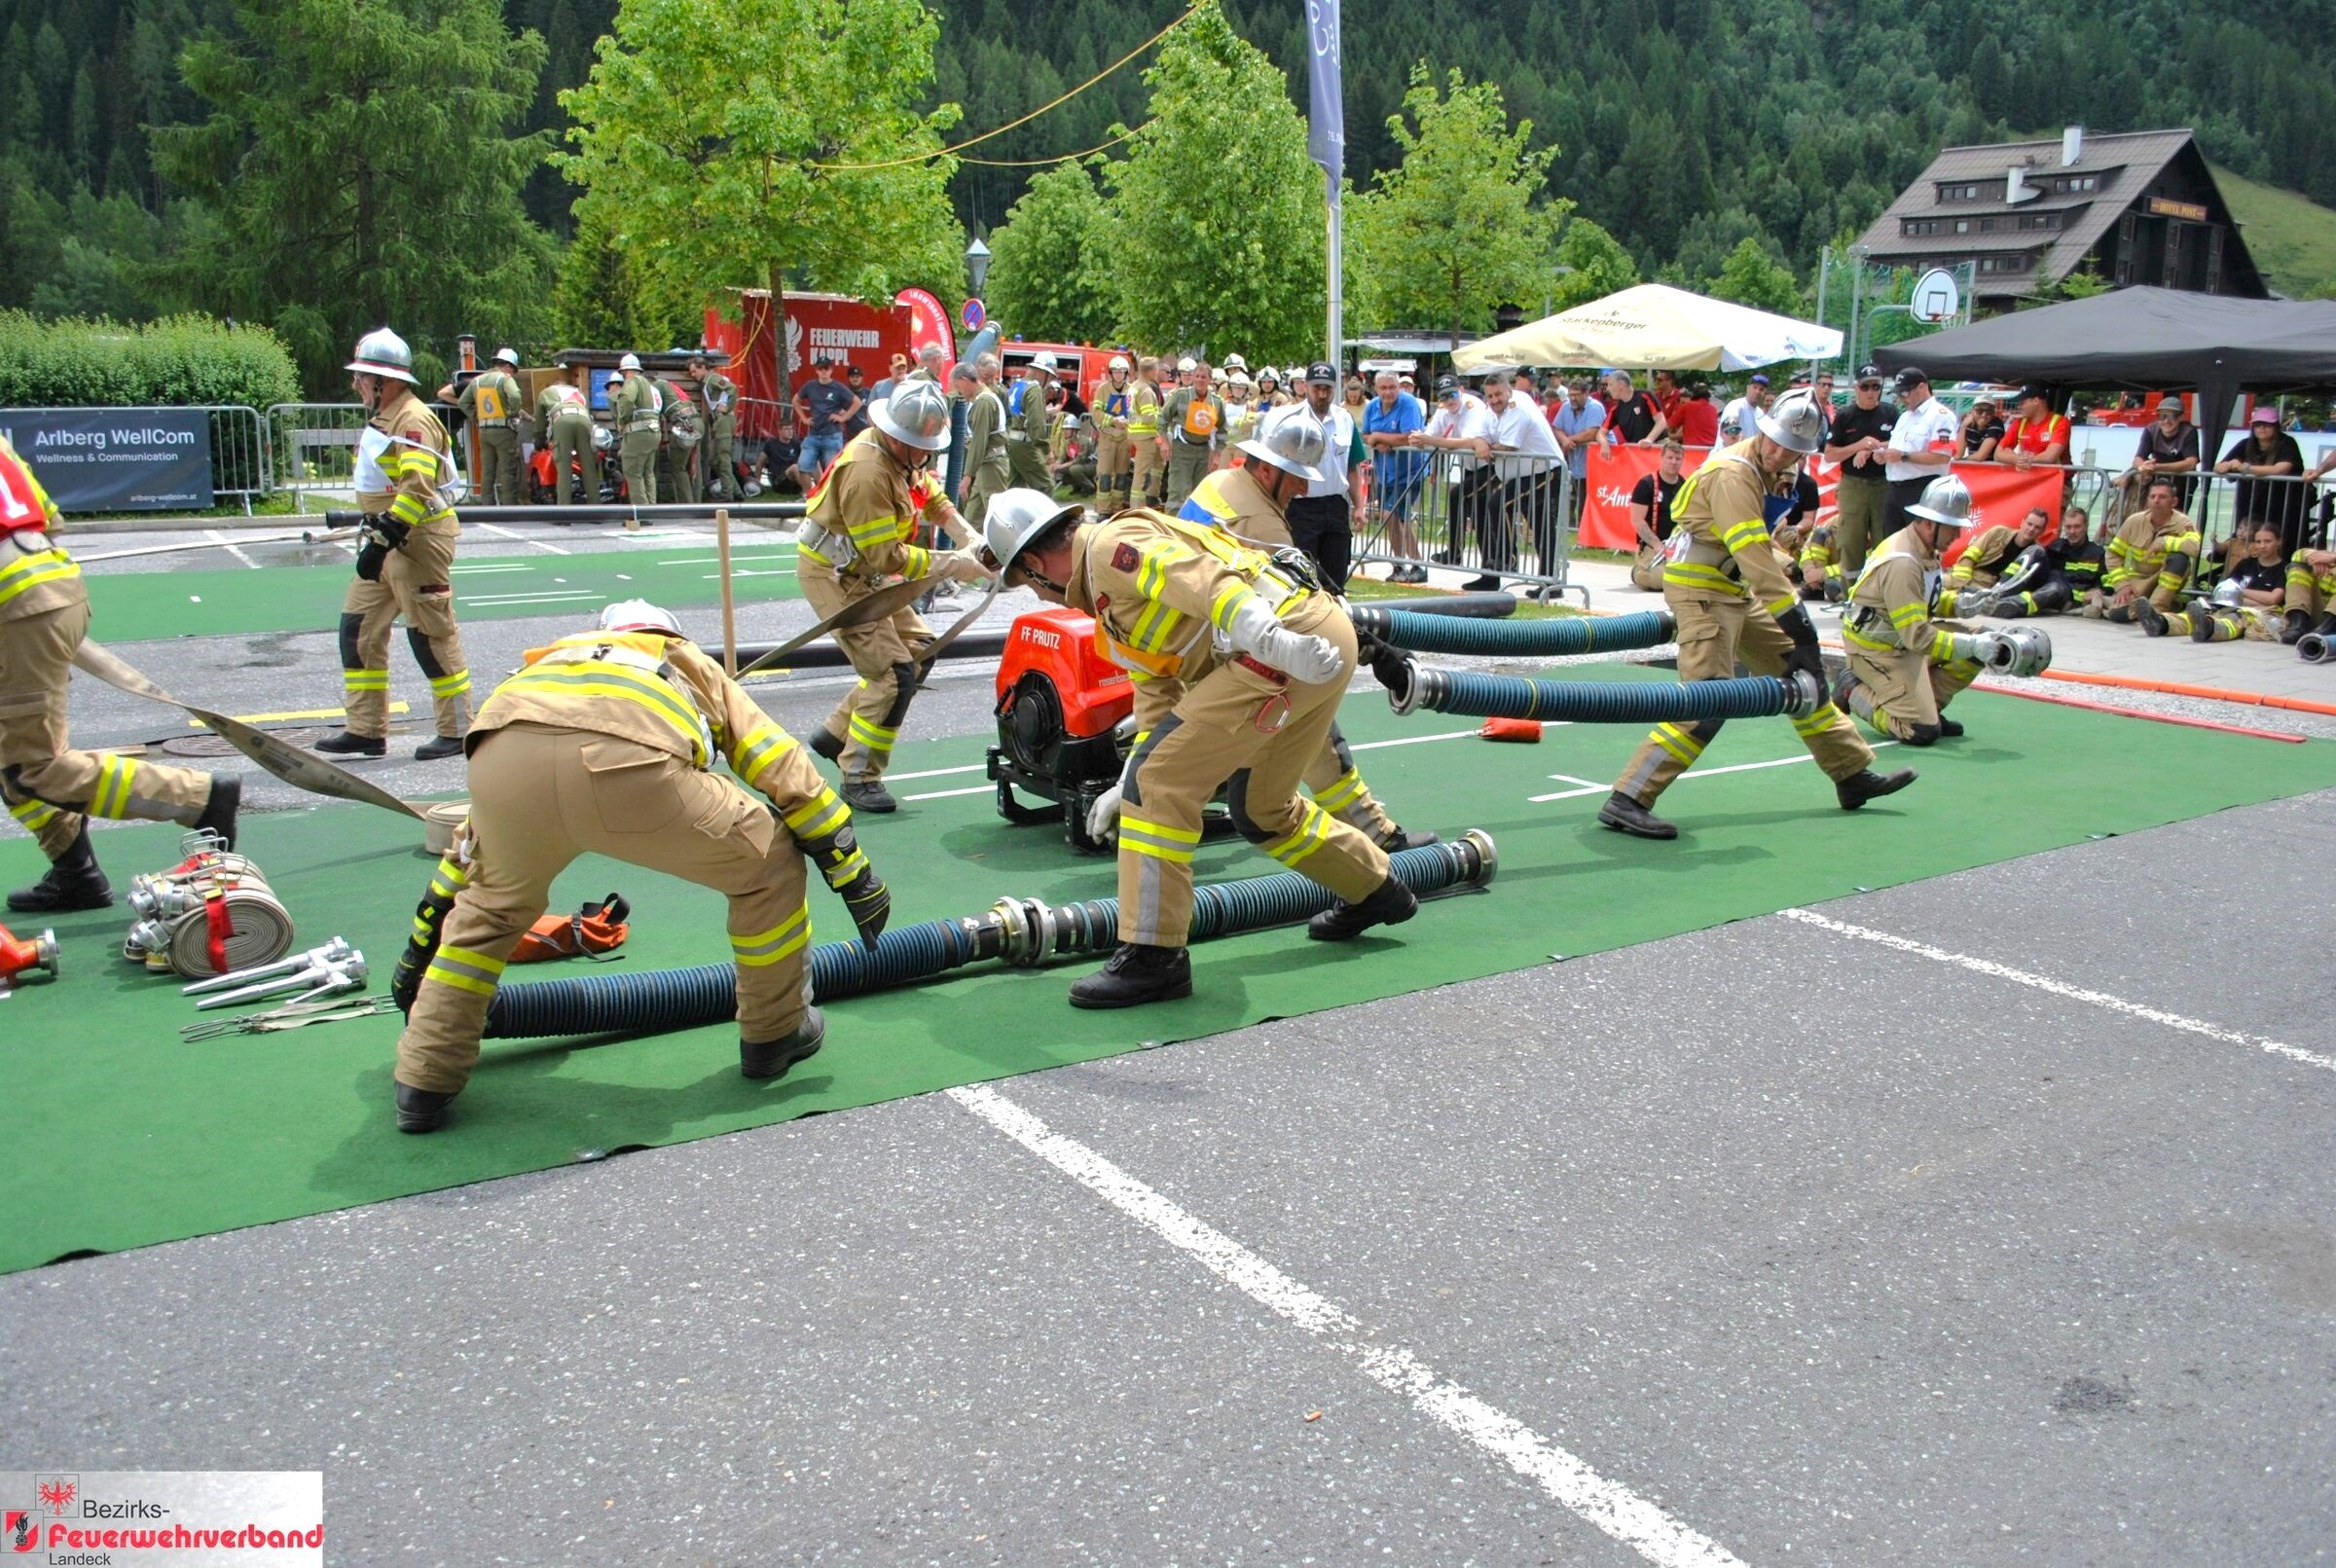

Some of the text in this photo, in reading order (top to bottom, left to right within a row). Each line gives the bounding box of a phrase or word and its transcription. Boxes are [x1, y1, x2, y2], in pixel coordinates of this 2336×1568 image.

[2159, 201, 2197, 218] HOTEL POST
[810, 327, 880, 348] FEUERWEHR
[483, 395, 493, 414] 6
[1194, 410, 1210, 428] 6
[36, 428, 195, 449] Arlberg WellCom
[37, 452, 179, 463] Wellness & Communication
[130, 492, 198, 503] arlberg-wellcom.at
[1021, 625, 1061, 650] FF PRUTZ
